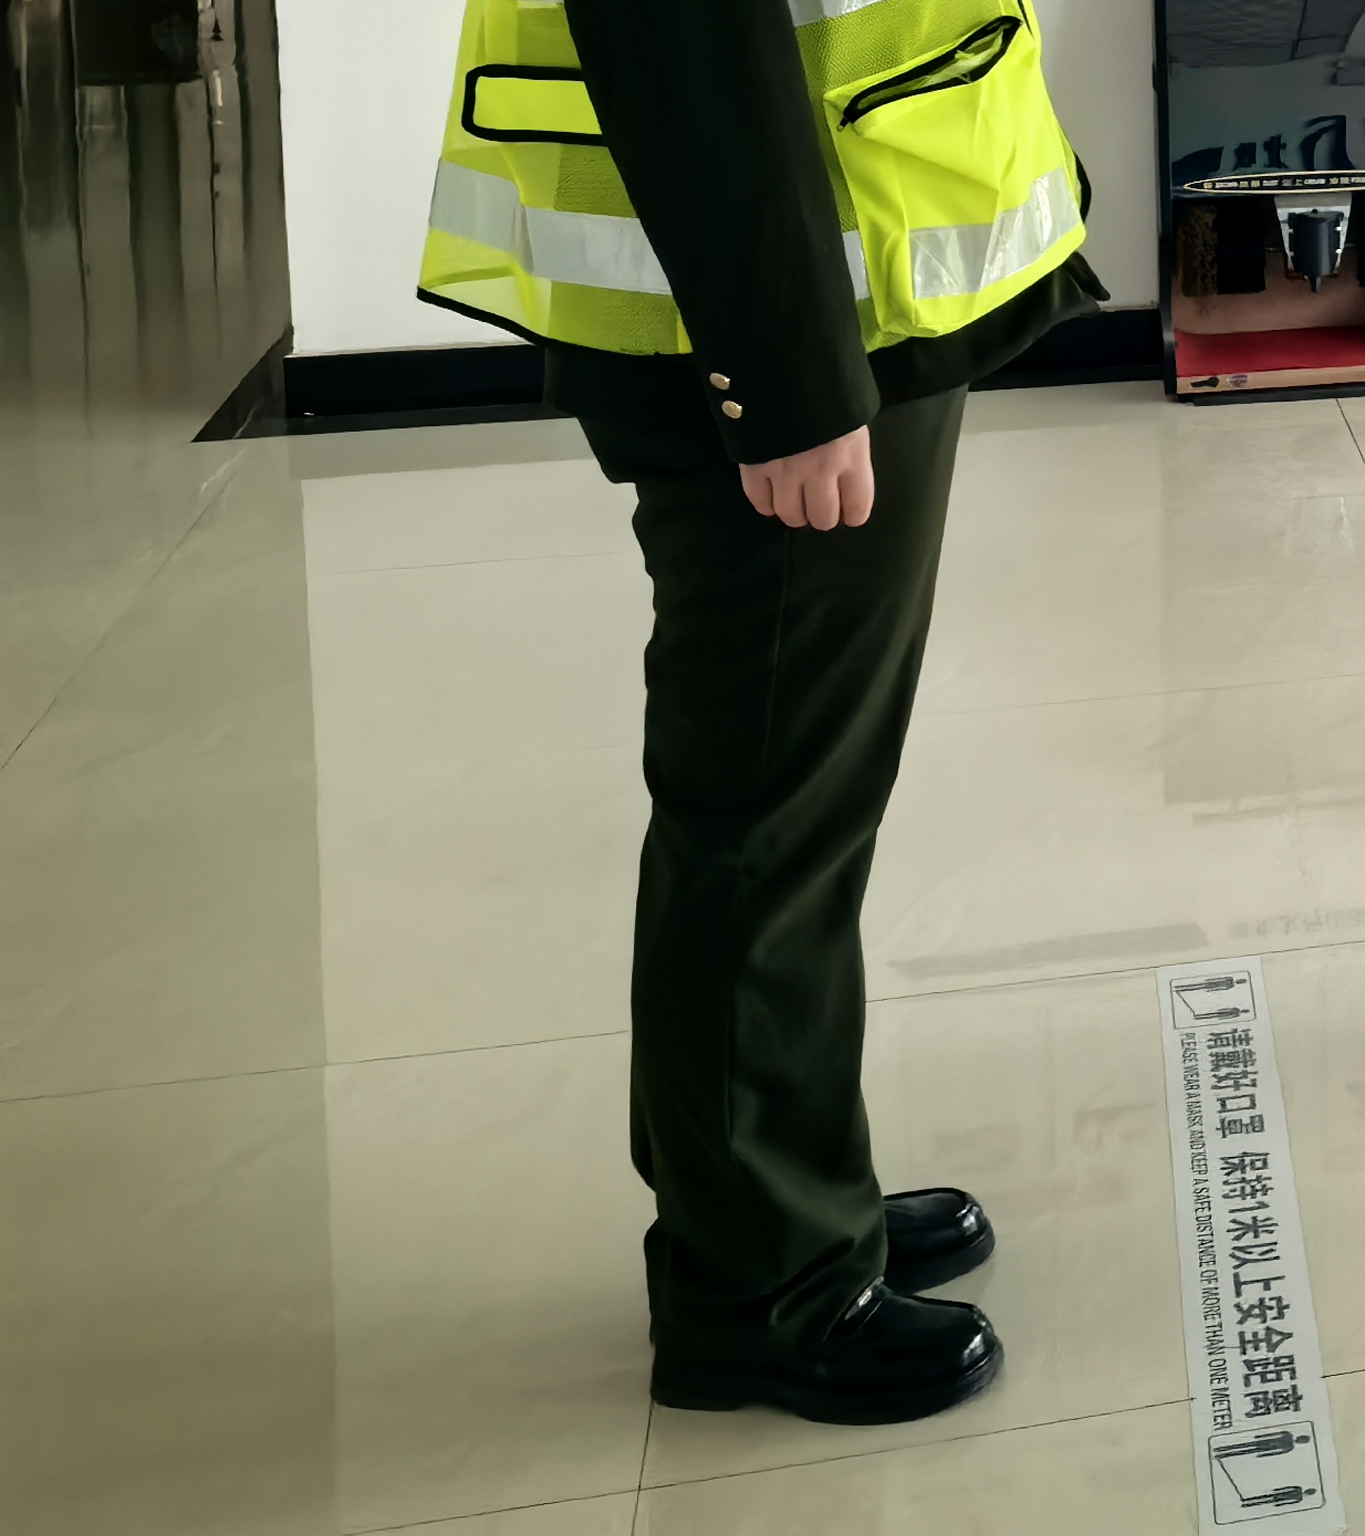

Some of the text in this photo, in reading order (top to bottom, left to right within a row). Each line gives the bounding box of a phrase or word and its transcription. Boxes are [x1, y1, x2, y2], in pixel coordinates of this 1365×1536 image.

[1179, 1031, 1199, 1064] PLEASE
[1183, 1064, 1201, 1092] WEAR
[1186, 1101, 1204, 1130] MASK
[1189, 1129, 1207, 1150] AND
[1190, 1150, 1209, 1176] KEEP
[1192, 1178, 1210, 1187] A
[1192, 1187, 1212, 1217] SAFE
[1205, 1027, 1304, 1419] 请戴好口罩 保持1米以上安全距离
[1195, 1215, 1217, 1268] DISTANCE
[1200, 1269, 1219, 1285] OF
[1201, 1286, 1222, 1321] MORE
[1205, 1321, 1226, 1356] THAN
[1208, 1358, 1229, 1385] ONE
[1210, 1386, 1233, 1432] METER
